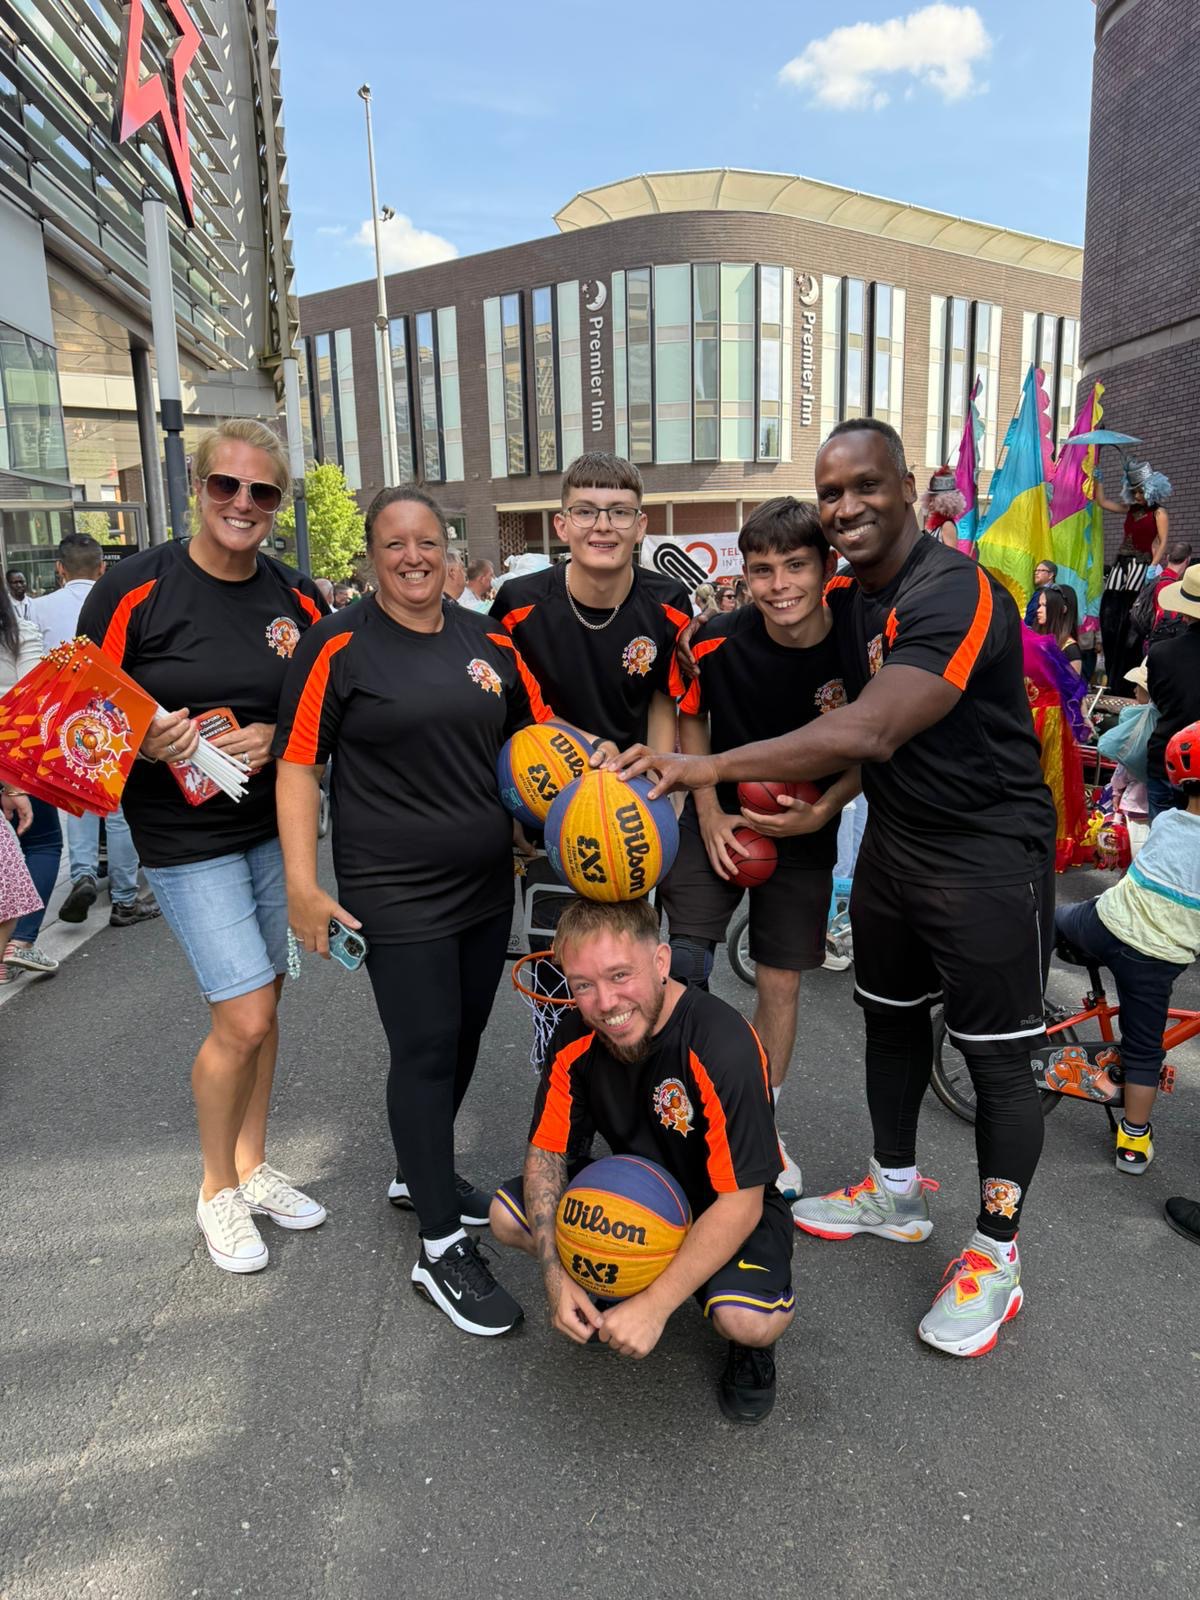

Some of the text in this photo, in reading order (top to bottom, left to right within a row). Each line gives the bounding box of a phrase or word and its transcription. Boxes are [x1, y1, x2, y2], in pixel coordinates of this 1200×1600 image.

[589, 316, 605, 432] Premier Inn
[800, 311, 816, 426] Premier Inn
[720, 547, 740, 556] TEL
[550, 733, 585, 779] Wils
[615, 802, 650, 894] Wilson
[563, 1197, 647, 1246] Wilson
